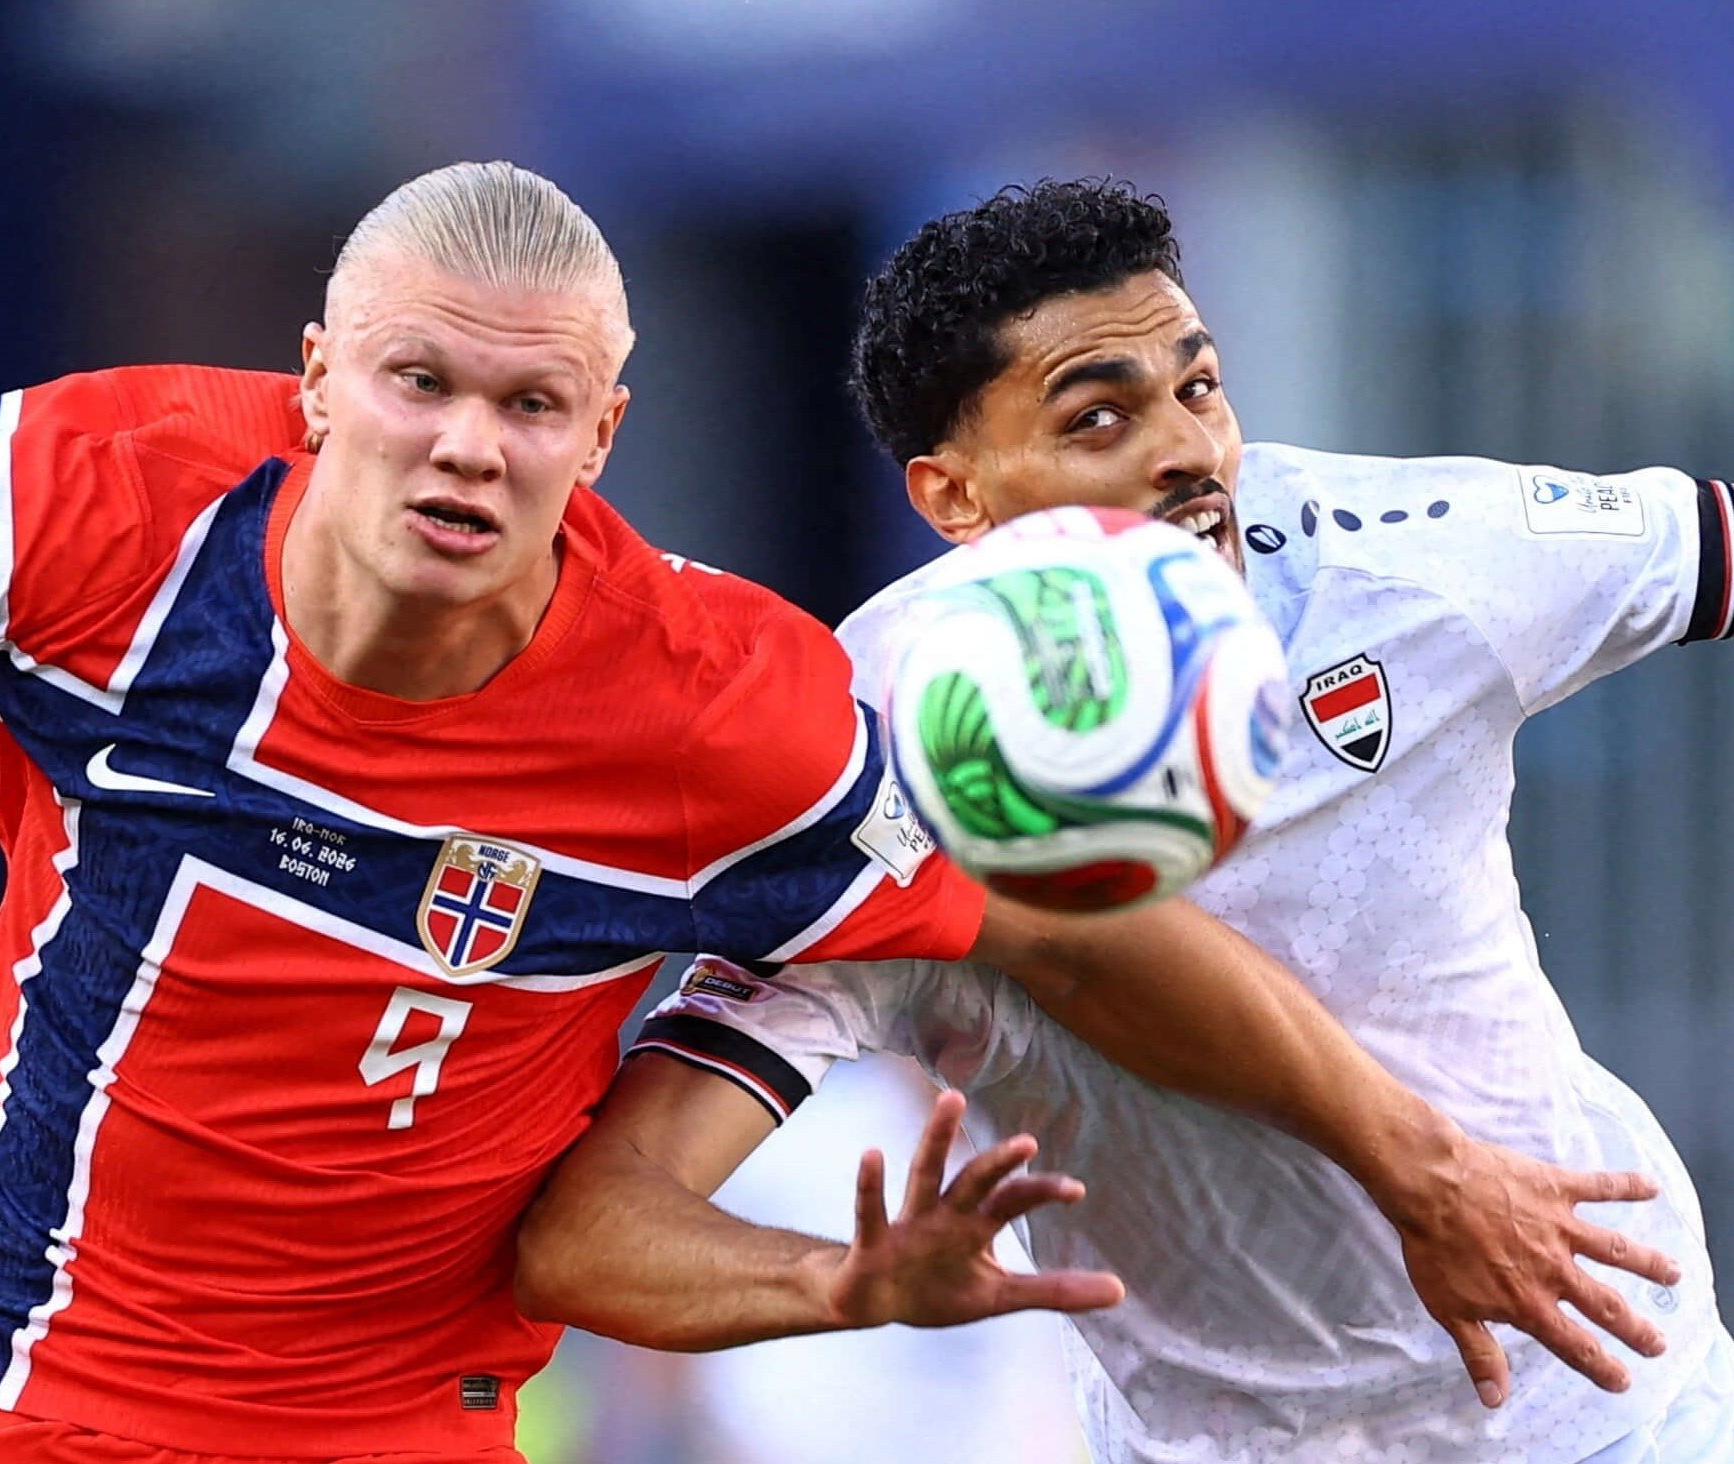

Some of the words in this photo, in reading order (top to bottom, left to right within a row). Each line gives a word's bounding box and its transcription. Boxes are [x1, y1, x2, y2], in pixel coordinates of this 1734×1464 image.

[1316, 664, 1363, 692] IRAQ
[478, 844, 511, 863] NORGE
[279, 854, 330, 887] BOSTON
[705, 976, 751, 995] DEBUT
[357, 986, 474, 1130] 9
